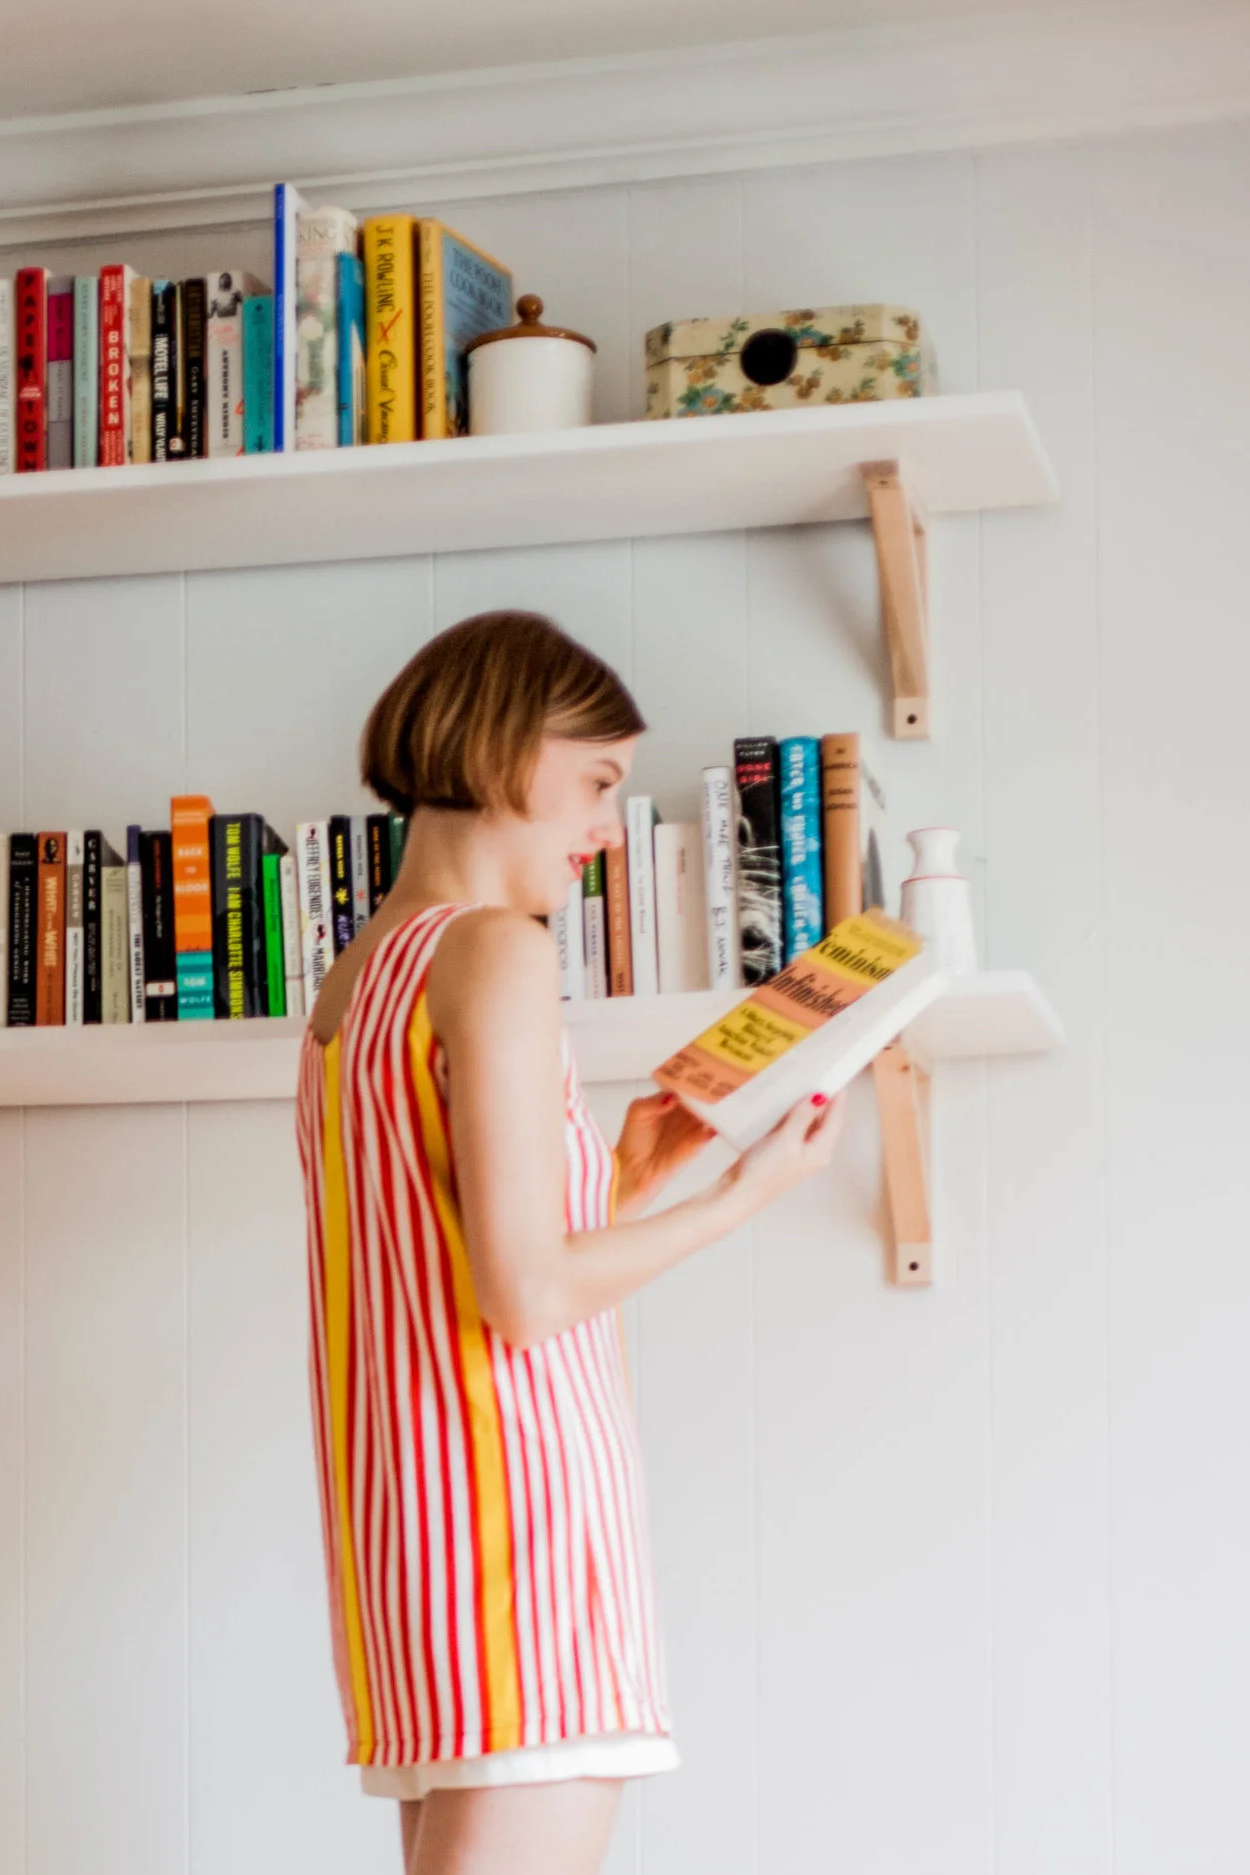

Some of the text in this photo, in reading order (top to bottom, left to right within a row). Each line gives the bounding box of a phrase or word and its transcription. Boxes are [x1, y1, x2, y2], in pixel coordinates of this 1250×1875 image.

[375, 225, 395, 314] J K ROWLING
[422, 272, 434, 297] THE
[154, 337, 169, 374] MOTEL
[107, 331, 119, 425] BROKEN
[154, 376, 168, 399] LIFE
[190, 366, 199, 393] GARY
[23, 401, 38, 470] TOWN
[155, 412, 166, 462] WILLY VLAUT
[716, 780, 729, 809] ONE
[226, 823, 241, 844] TOM
[87, 838, 97, 910] CARVER
[226, 847, 241, 878] WOLFE
[305, 837, 323, 920] JEFFREY EUGENIDES
[45, 877, 58, 913] WHAT
[227, 893, 241, 909] AM
[44, 930, 58, 967] WHAT
[227, 912, 242, 968] CHARLOTTE
[716, 936, 728, 978] NOVAK
[229, 971, 244, 1018] SIMMONS
